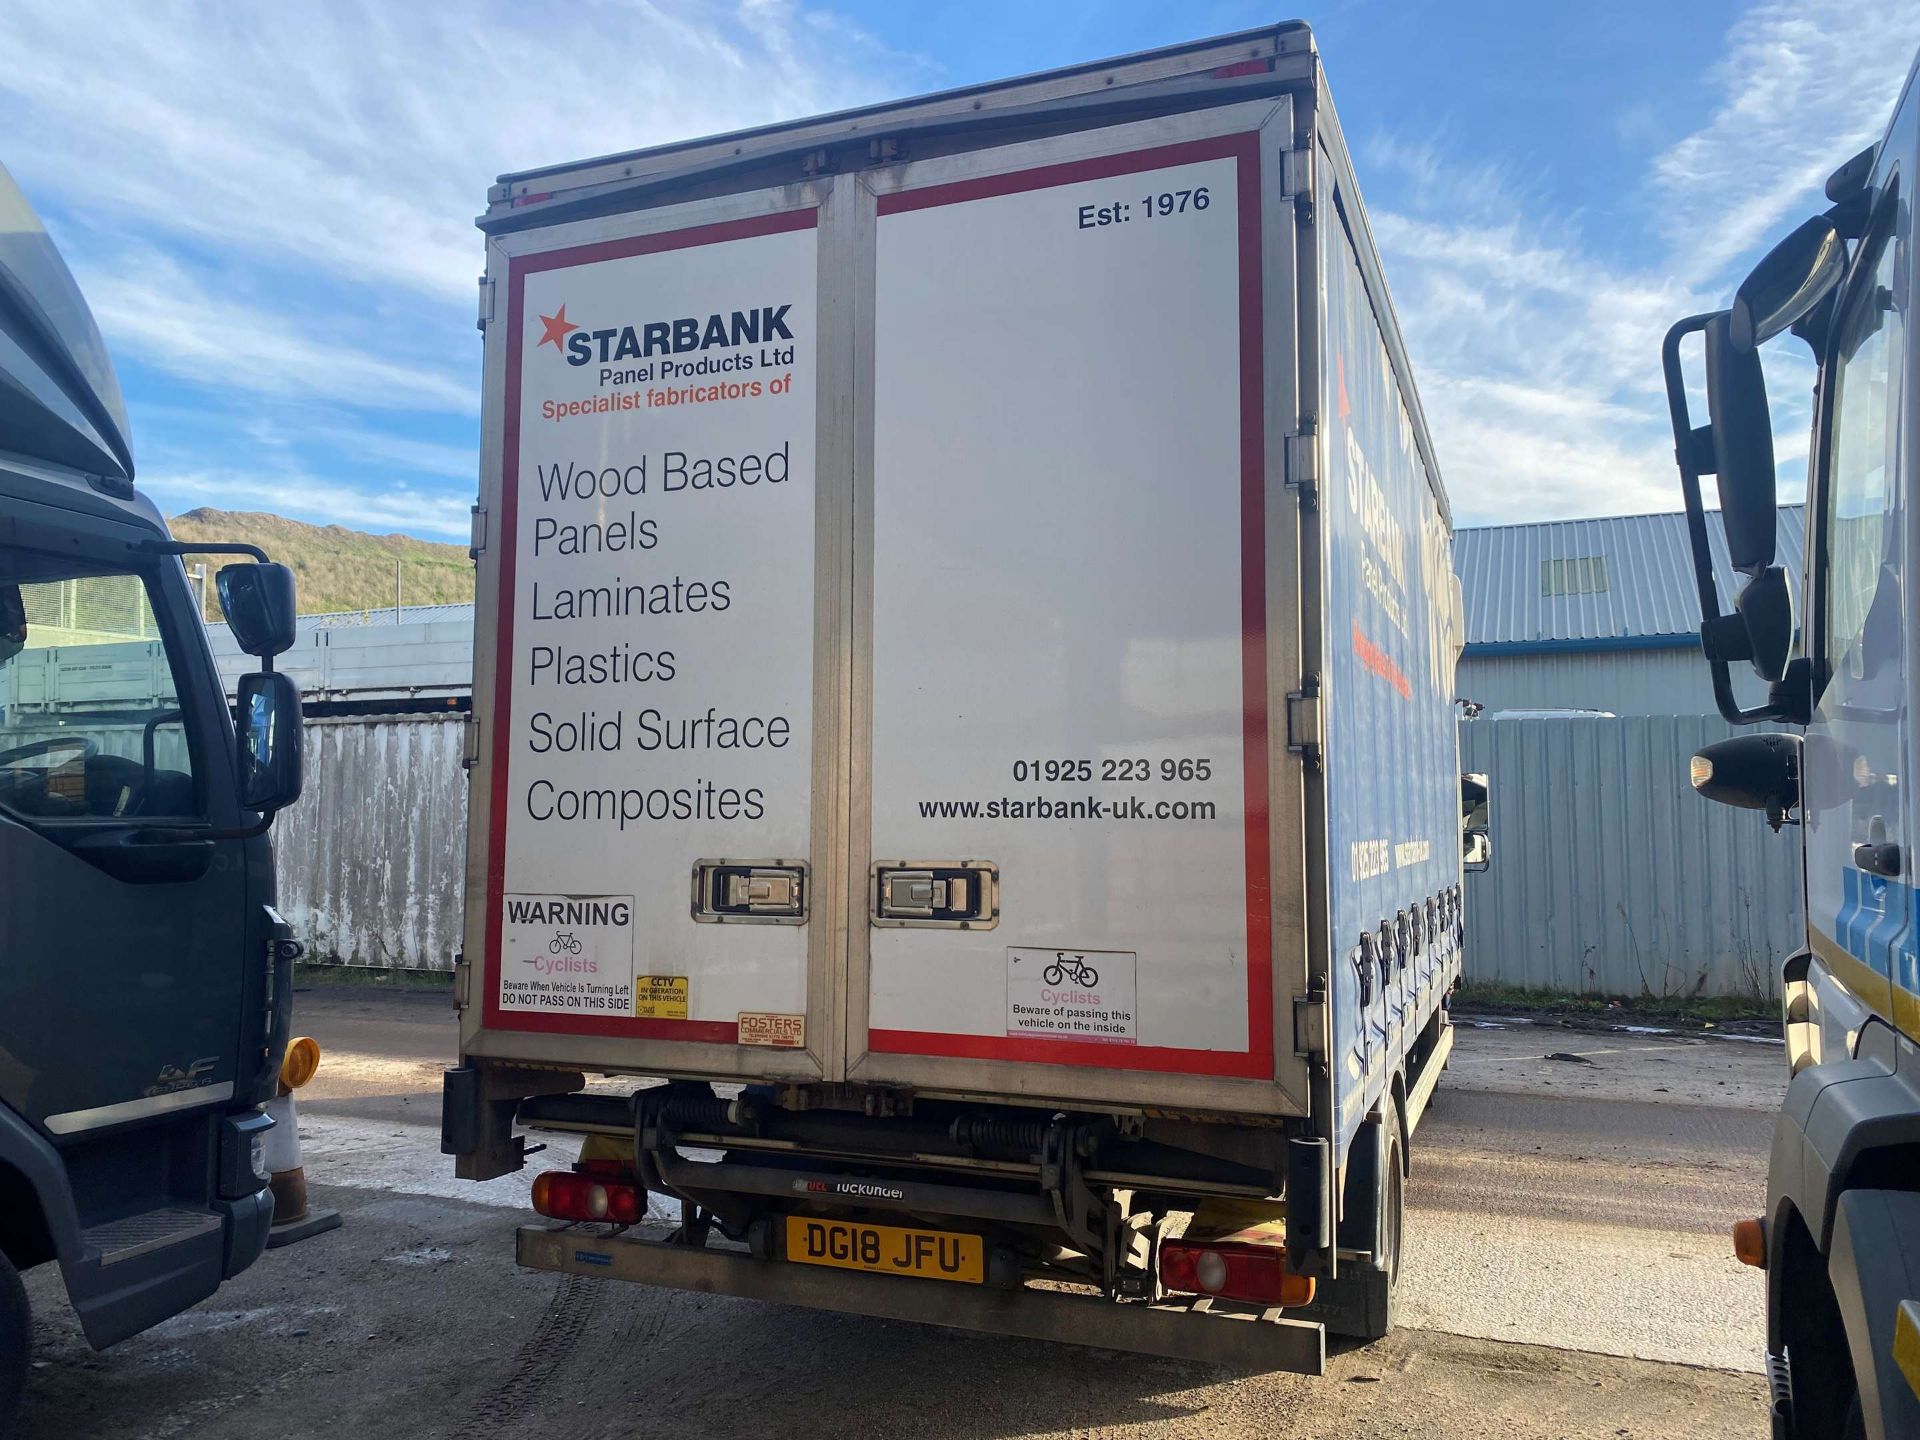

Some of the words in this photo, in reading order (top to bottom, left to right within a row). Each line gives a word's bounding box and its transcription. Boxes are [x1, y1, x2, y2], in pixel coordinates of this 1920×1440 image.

[1079, 202, 1130, 229] Est:
[1142, 187, 1210, 218] 1976
[566, 304, 794, 367] STARBANK
[600, 364, 654, 386] Panel
[662, 353, 753, 379] Products
[761, 346, 794, 367] Ltd
[542, 391, 640, 422] Specialist
[647, 380, 762, 407] fabricators
[770, 374, 792, 394] of
[538, 455, 646, 502] Wood
[663, 441, 789, 492] Based
[534, 511, 658, 556] Panels
[532, 576, 730, 620] Laminates
[530, 643, 676, 685] Plastics
[529, 711, 622, 752] Solid
[637, 708, 790, 751] Surface
[1013, 760, 1092, 782] 01925
[1101, 759, 1150, 781] 223
[1160, 758, 1211, 781] 965
[527, 778, 764, 830] Composites
[919, 796, 1216, 820] www.starbank-uk.com
[508, 901, 629, 926] WARNING
[534, 956, 598, 975] Cyclists
[503, 980, 528, 990] Beware
[530, 981, 549, 991] When
[551, 982, 577, 993] Vehicle
[578, 983, 584, 993] Is
[586, 983, 613, 997] Turning
[615, 985, 629, 995] Left
[651, 977, 674, 986] CCTV
[502, 993, 516, 1004] DO
[518, 994, 538, 1005] NOT
[540, 994, 564, 1007] PASS
[567, 996, 580, 1007] ON
[584, 997, 605, 1008] THIS
[607, 998, 630, 1010] SIDE
[1041, 988, 1101, 1005] Cyclists
[741, 1017, 802, 1030] FOSTERS
[1013, 1004, 1050, 1015] Beware
[1053, 1007, 1064, 1016] of
[1067, 1008, 1108, 1021] passing
[1111, 1011, 1131, 1020] this
[740, 1027, 788, 1035] COMMERCIALS
[1018, 1018, 1054, 1028] vehicle
[1057, 1021, 1071, 1030] on
[1074, 1021, 1090, 1031] the
[1093, 1022, 1126, 1033] inside
[807, 1223, 880, 1264] DG18
[892, 1234, 959, 1273] JFU
